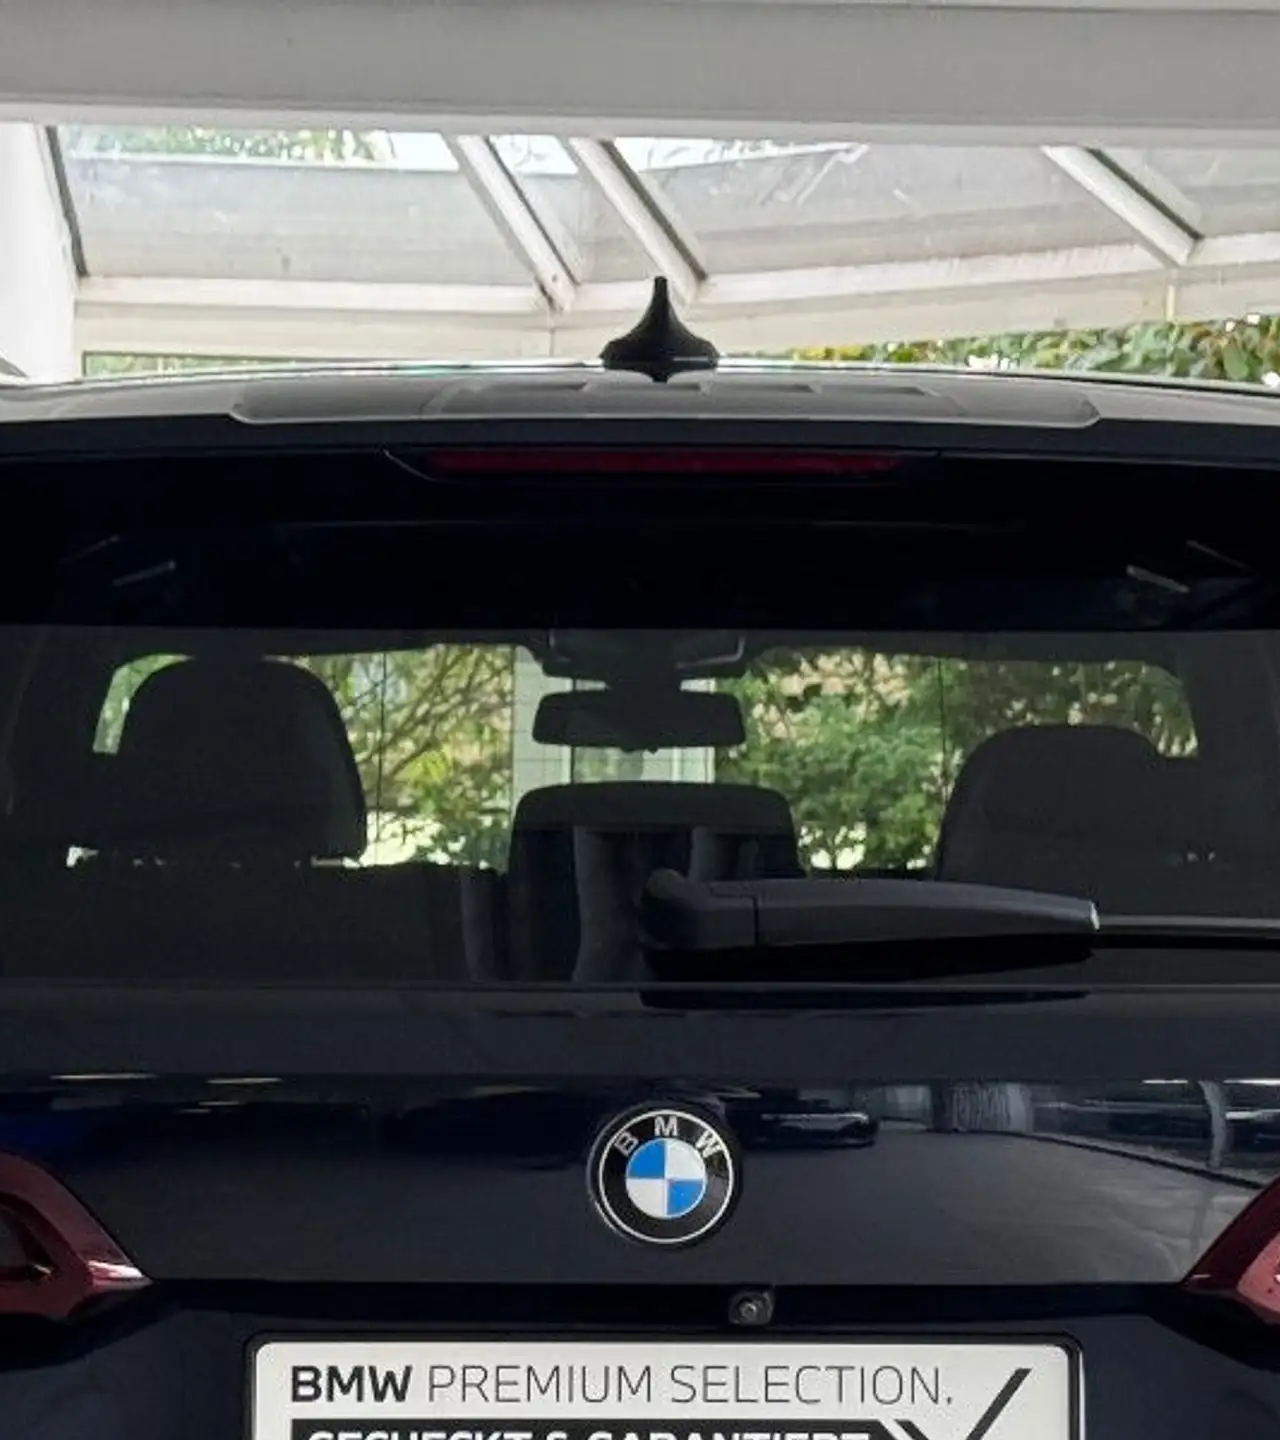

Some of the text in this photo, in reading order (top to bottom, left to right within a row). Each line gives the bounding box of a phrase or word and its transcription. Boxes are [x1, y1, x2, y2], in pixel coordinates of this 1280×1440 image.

[614, 1116, 722, 1158] BMW
[291, 1364, 952, 1405] BMW PREMIUM SELECTION.
